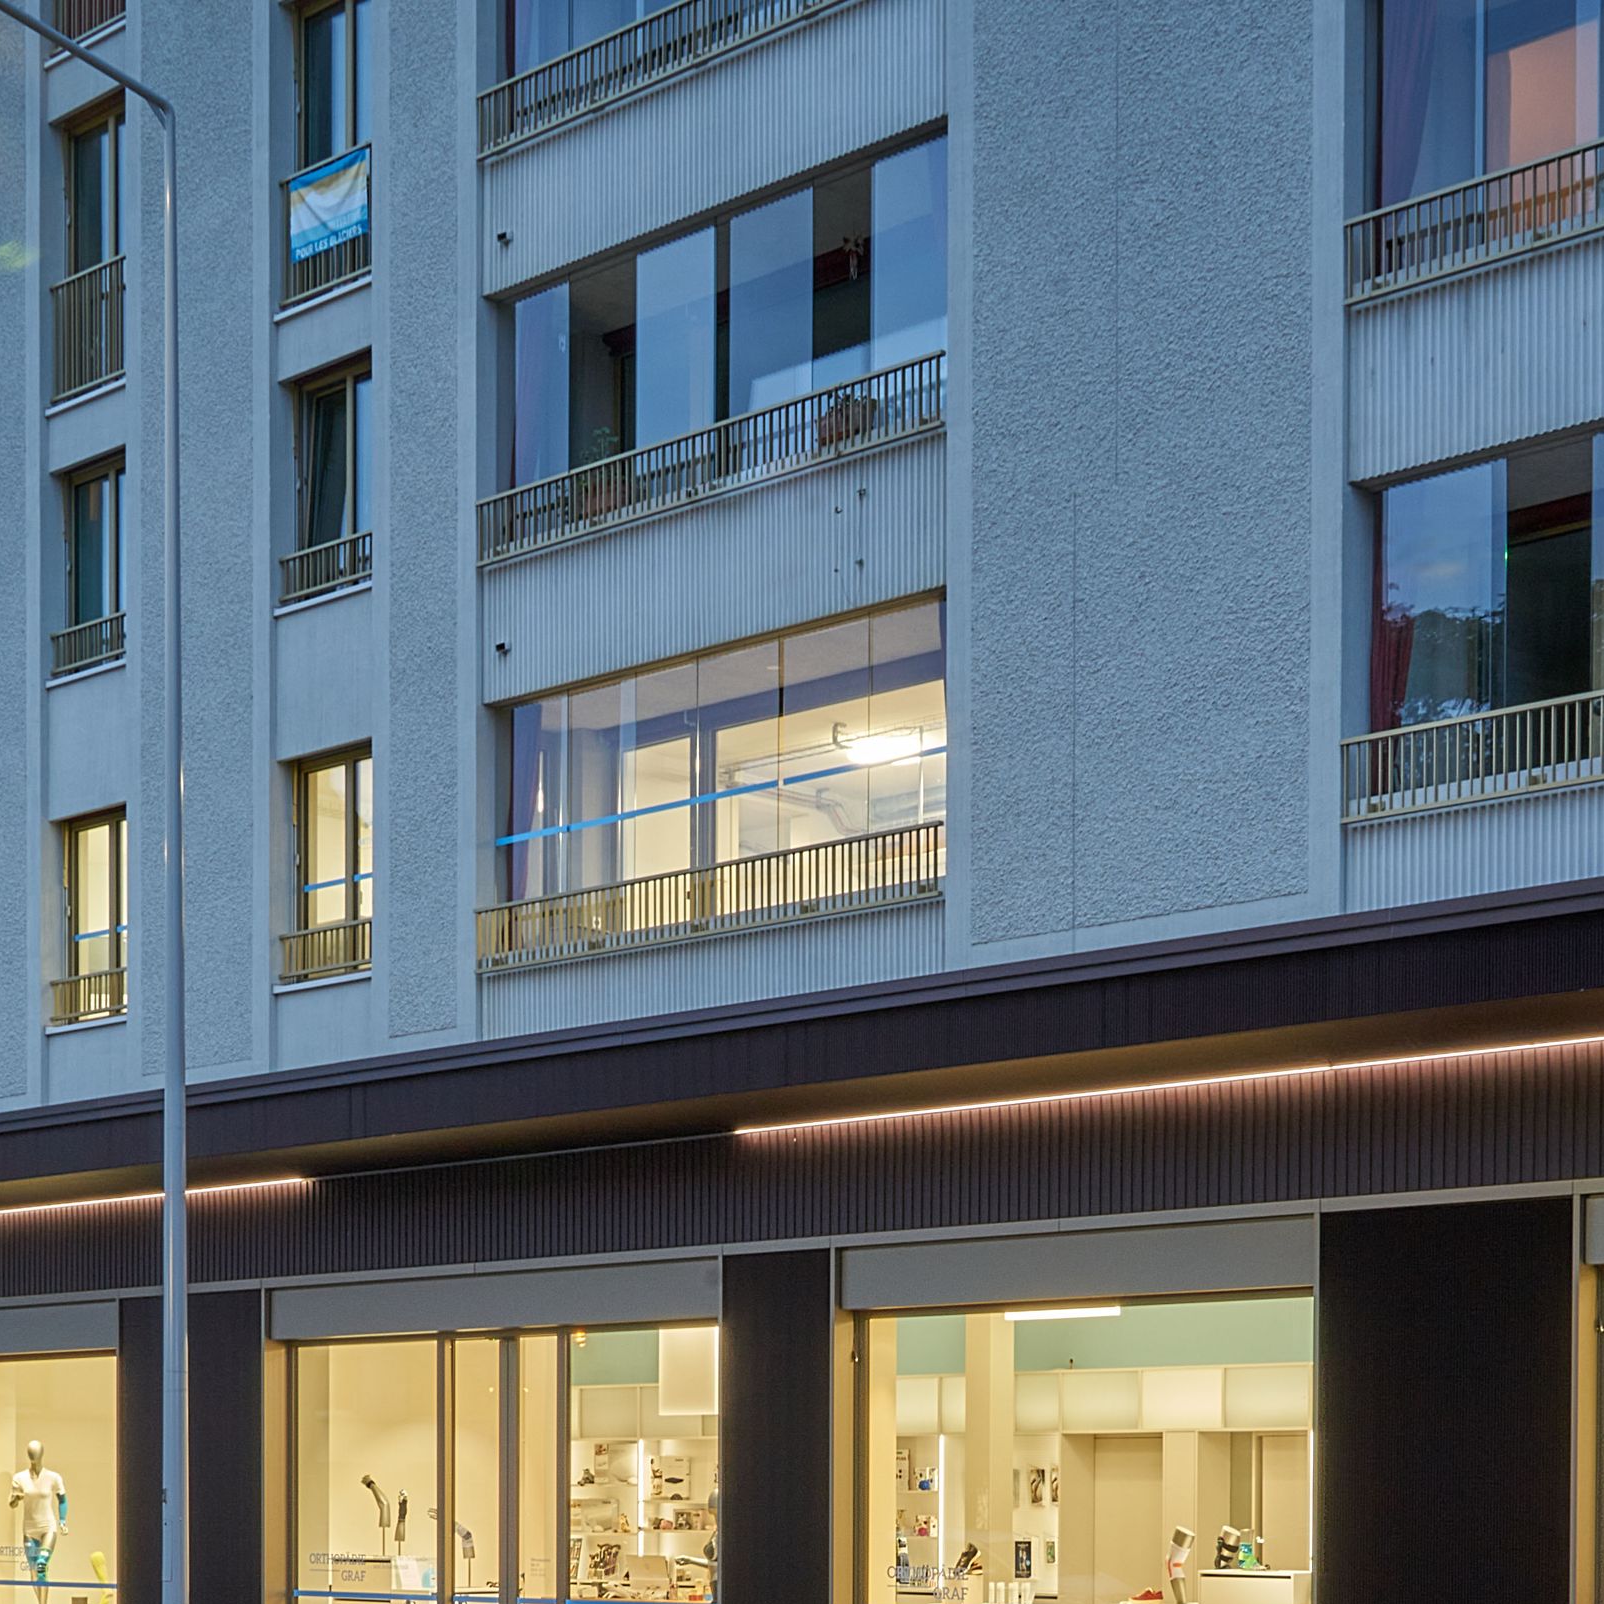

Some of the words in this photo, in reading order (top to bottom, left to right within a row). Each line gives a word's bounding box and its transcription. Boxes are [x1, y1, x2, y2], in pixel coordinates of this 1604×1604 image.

[296, 243, 314, 260] POUR
[315, 238, 328, 252] LES
[309, 1551, 366, 1566] ORTHOPÄDIE
[341, 1569, 366, 1582] GRAF
[933, 1586, 969, 1601] GRAF
